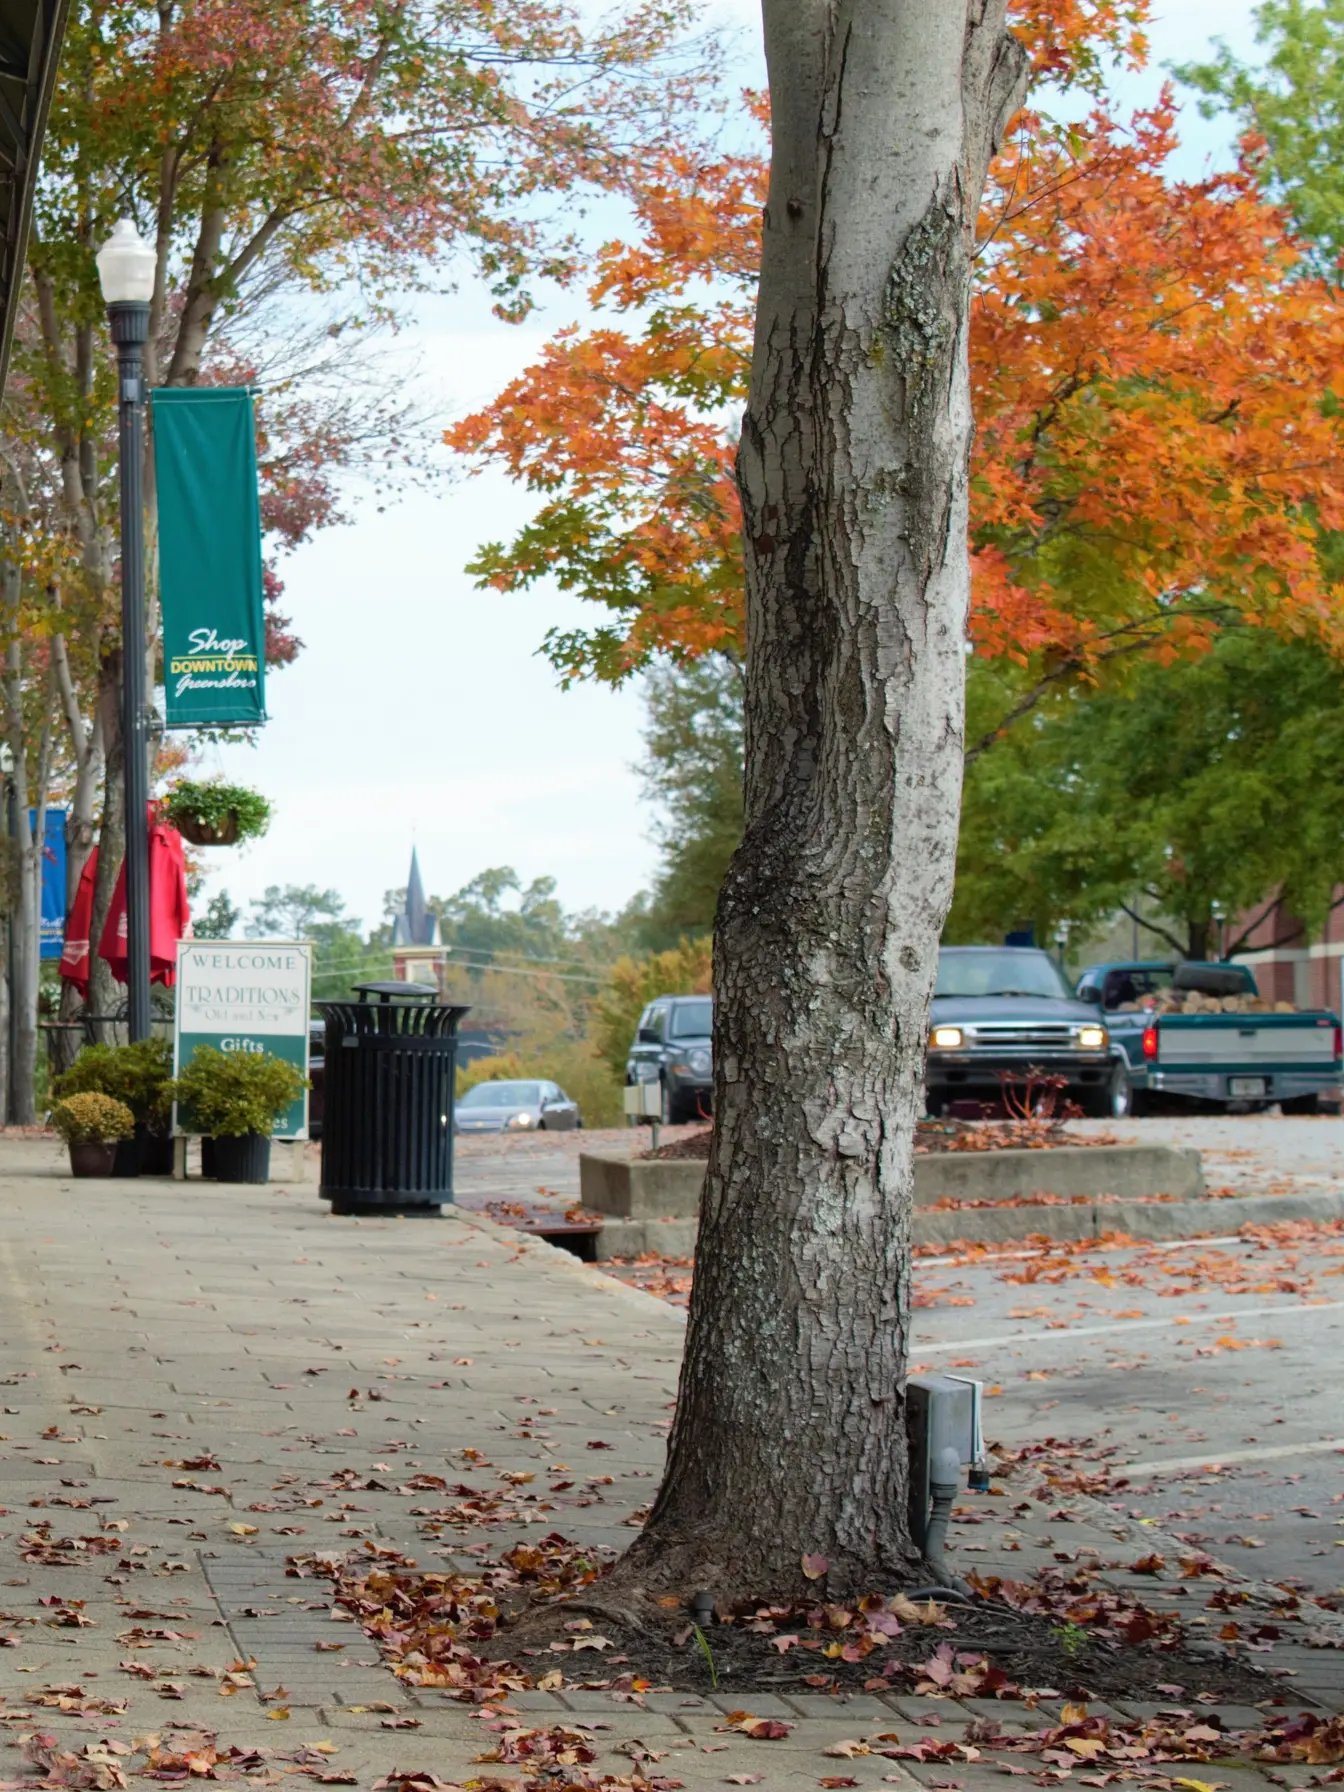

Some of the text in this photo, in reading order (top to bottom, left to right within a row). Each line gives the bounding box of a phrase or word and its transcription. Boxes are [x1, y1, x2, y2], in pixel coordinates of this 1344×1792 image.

[188, 628, 247, 660] Shop
[171, 660, 257, 673] DOWNTOWN
[192, 954, 297, 970] WELCOME
[186, 986, 301, 1005] TRADITIONS
[220, 1038, 264, 1053] Gifts
